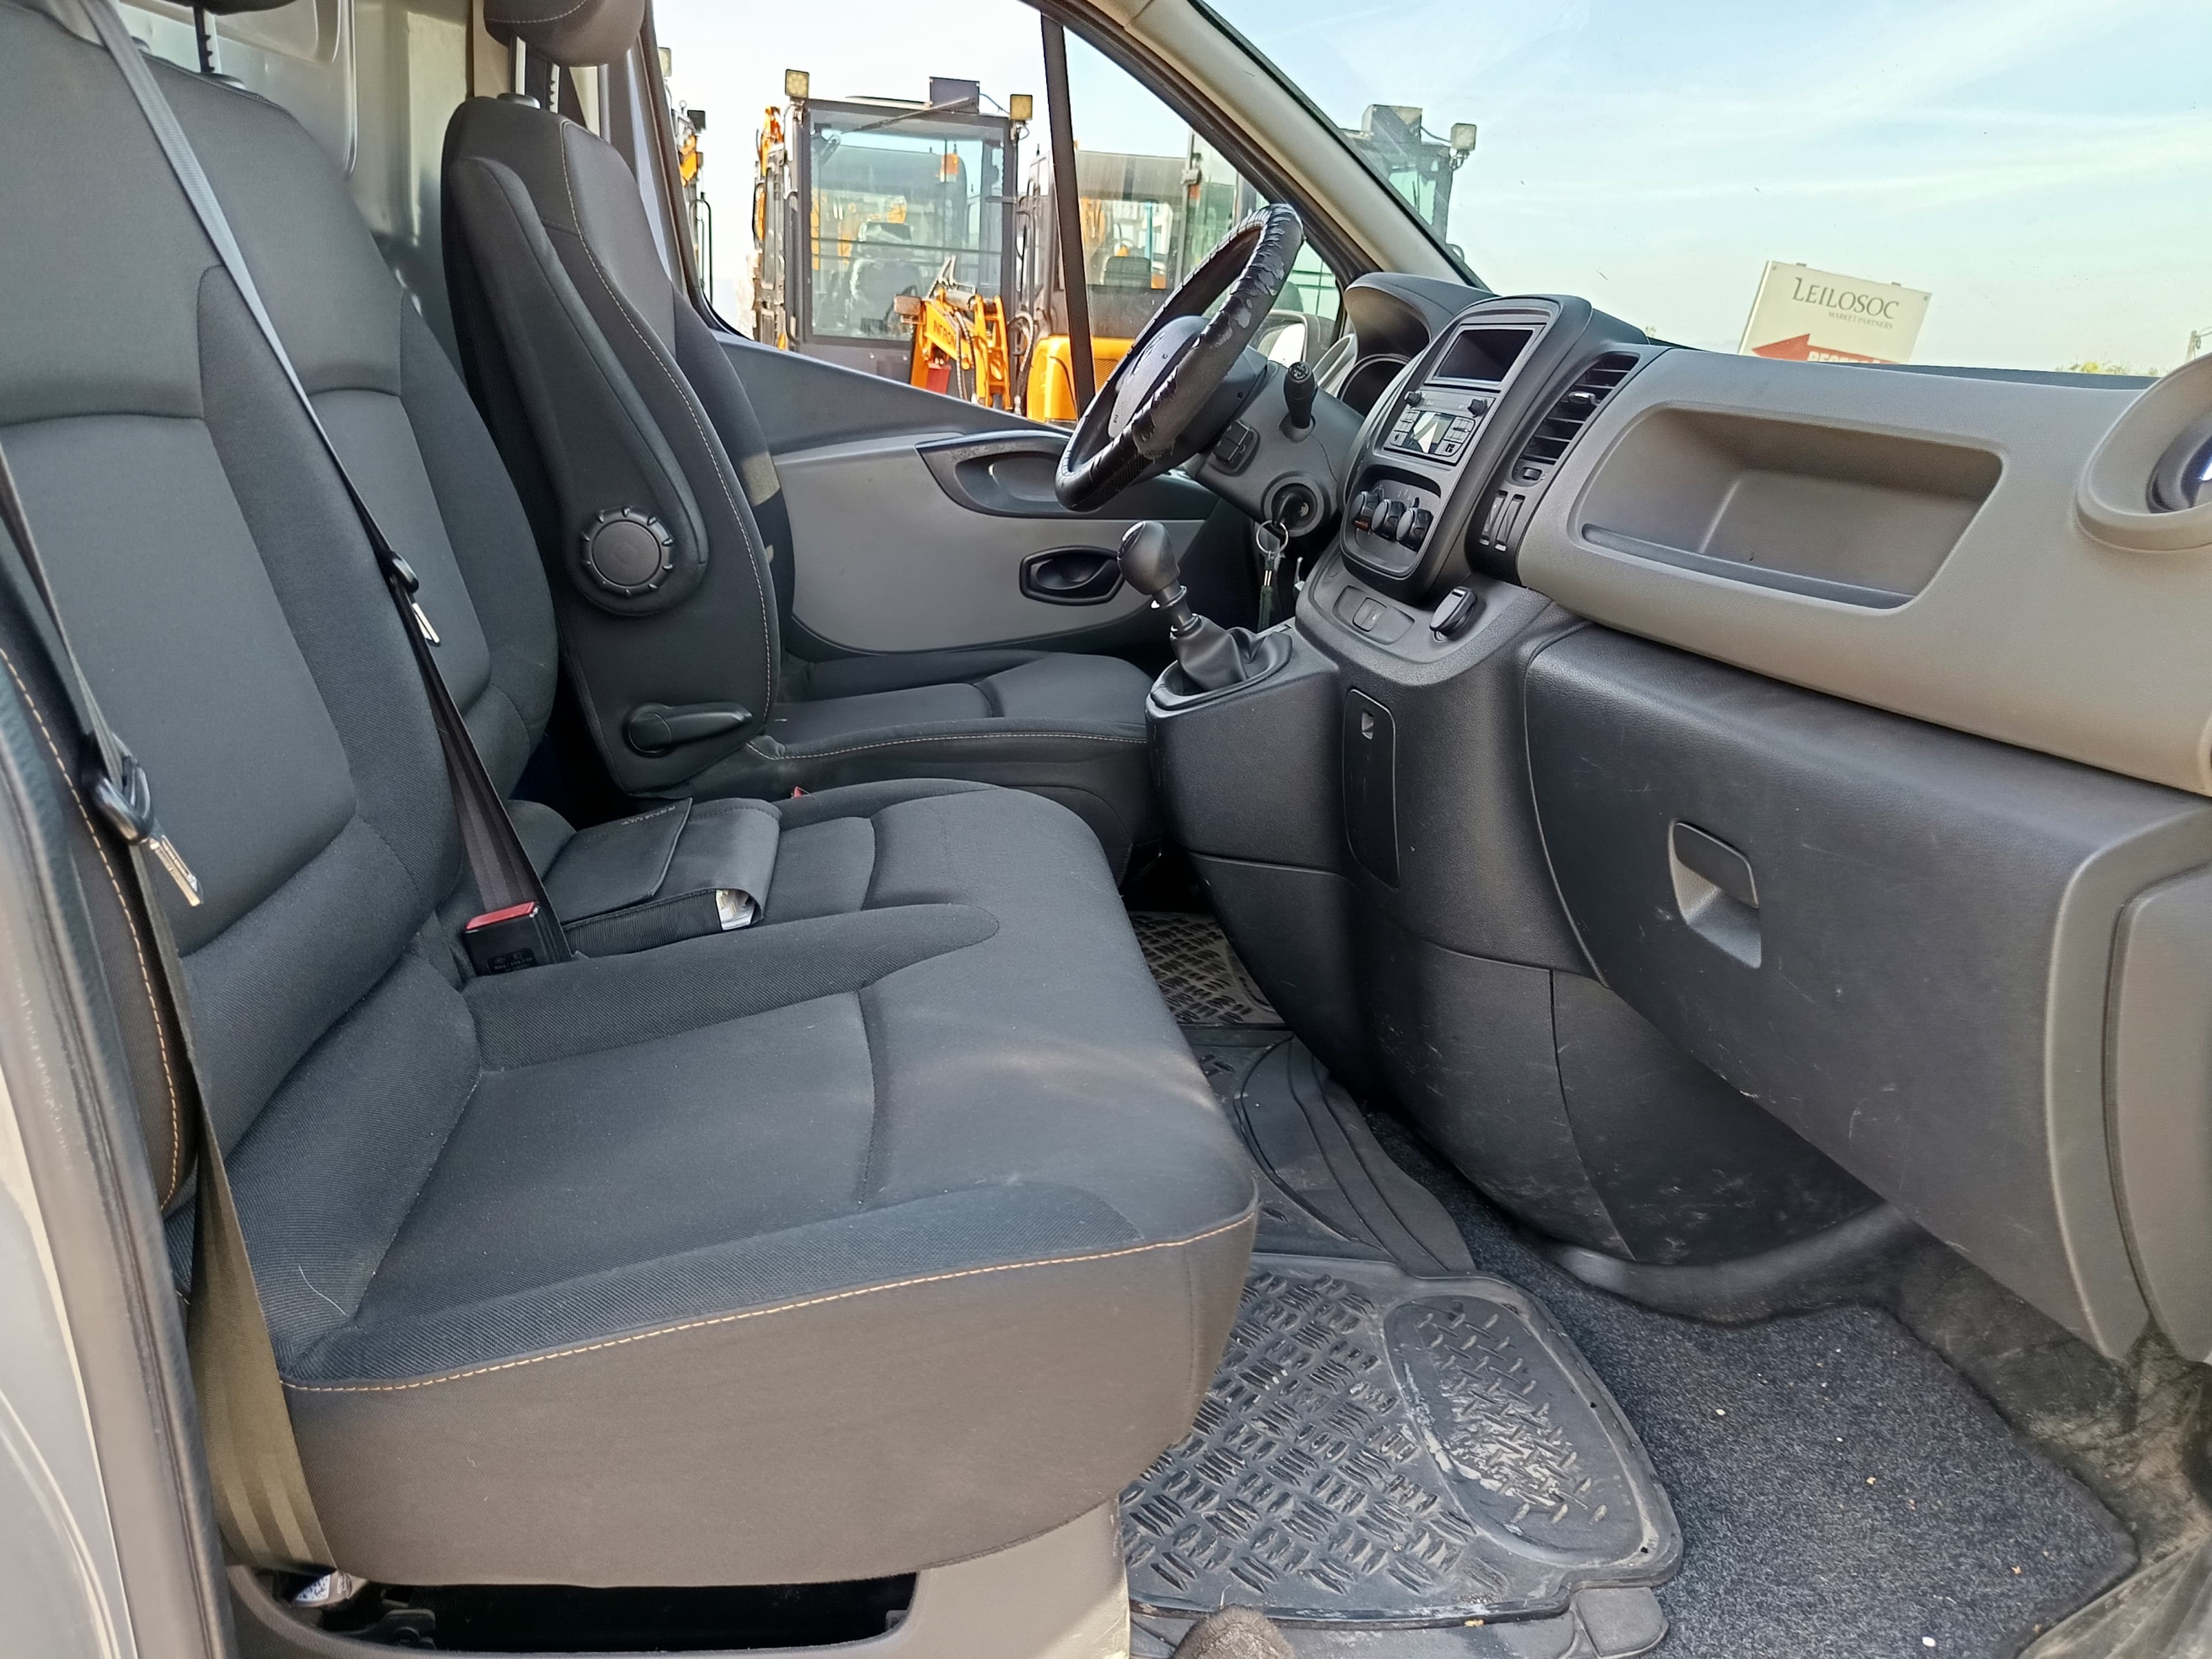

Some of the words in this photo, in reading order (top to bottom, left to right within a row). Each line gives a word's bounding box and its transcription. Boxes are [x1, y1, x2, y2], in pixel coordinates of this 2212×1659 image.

[1792, 277, 1899, 319] LEILOSOC
[1829, 312, 1857, 323] MARKET
[1858, 318, 1893, 329] PARTNERS
